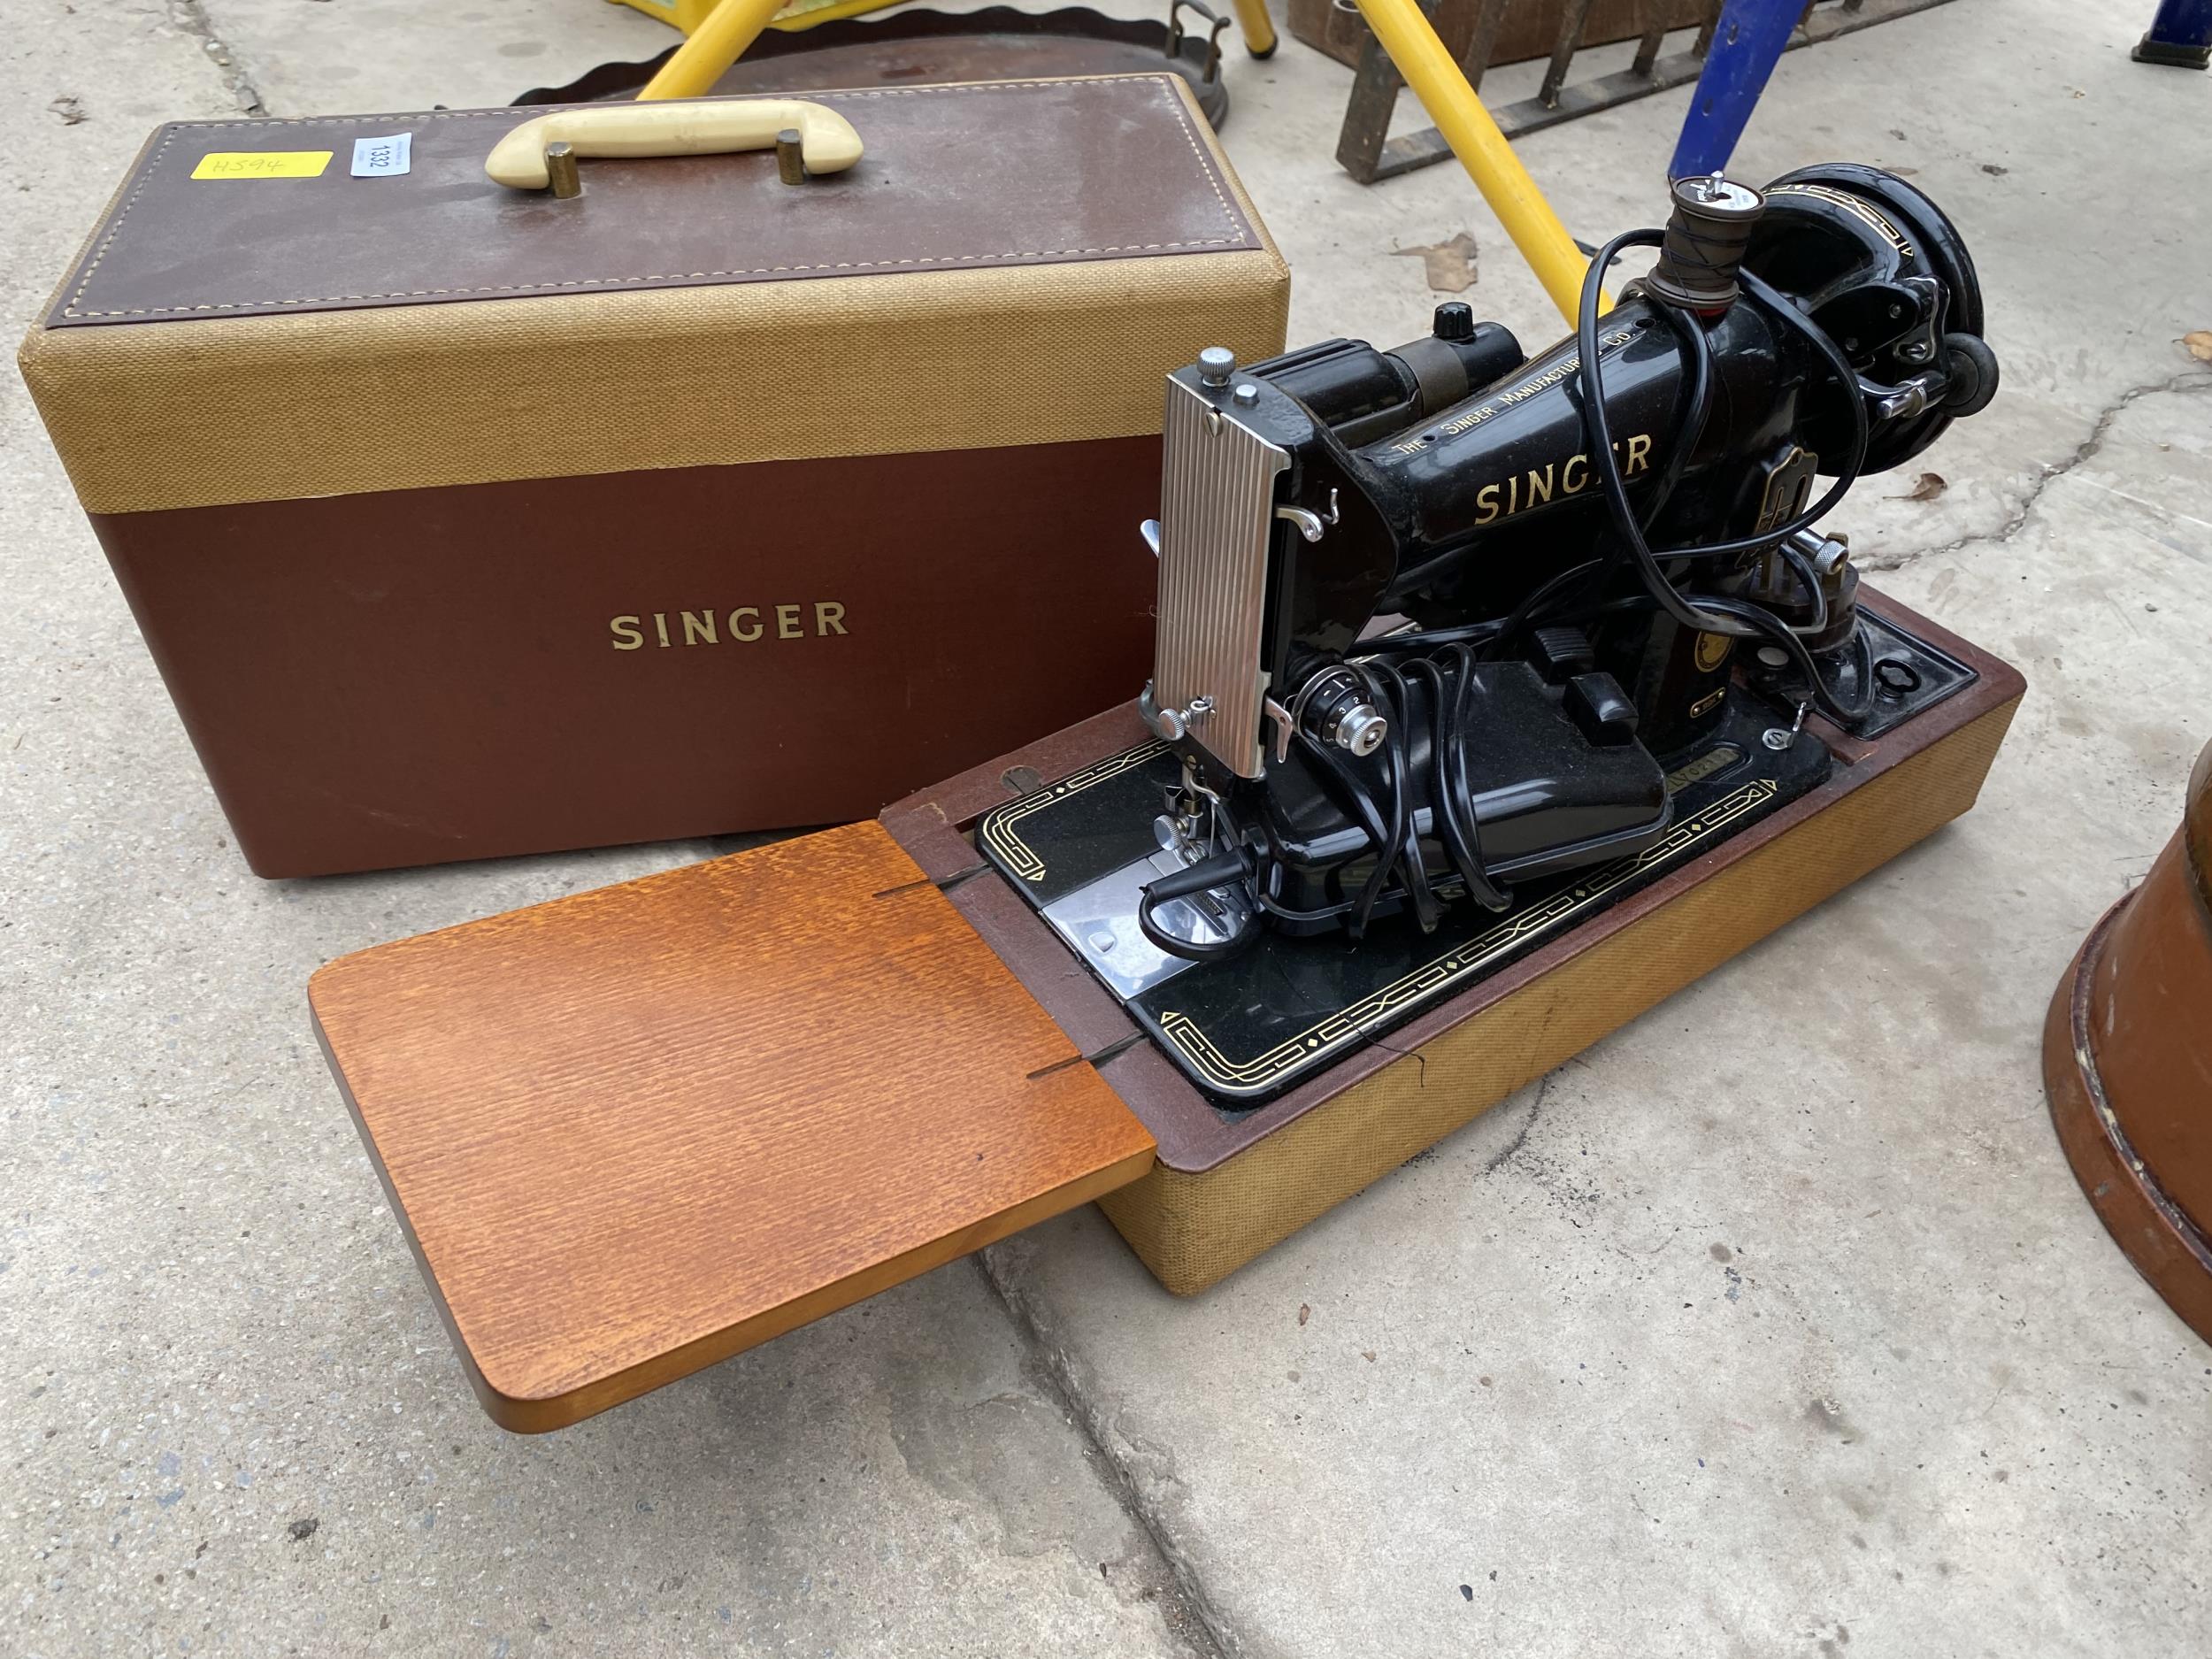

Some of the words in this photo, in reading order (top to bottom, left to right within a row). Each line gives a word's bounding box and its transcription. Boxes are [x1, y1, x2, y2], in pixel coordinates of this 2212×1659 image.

[370, 145, 389, 168] 1332
[1392, 441, 1428, 454] THE
[1440, 406, 1498, 434] SINGER
[1498, 351, 1602, 406] MANUFACTUR
[1475, 434, 1652, 525] SINGR
[610, 601, 849, 650] SINGER
